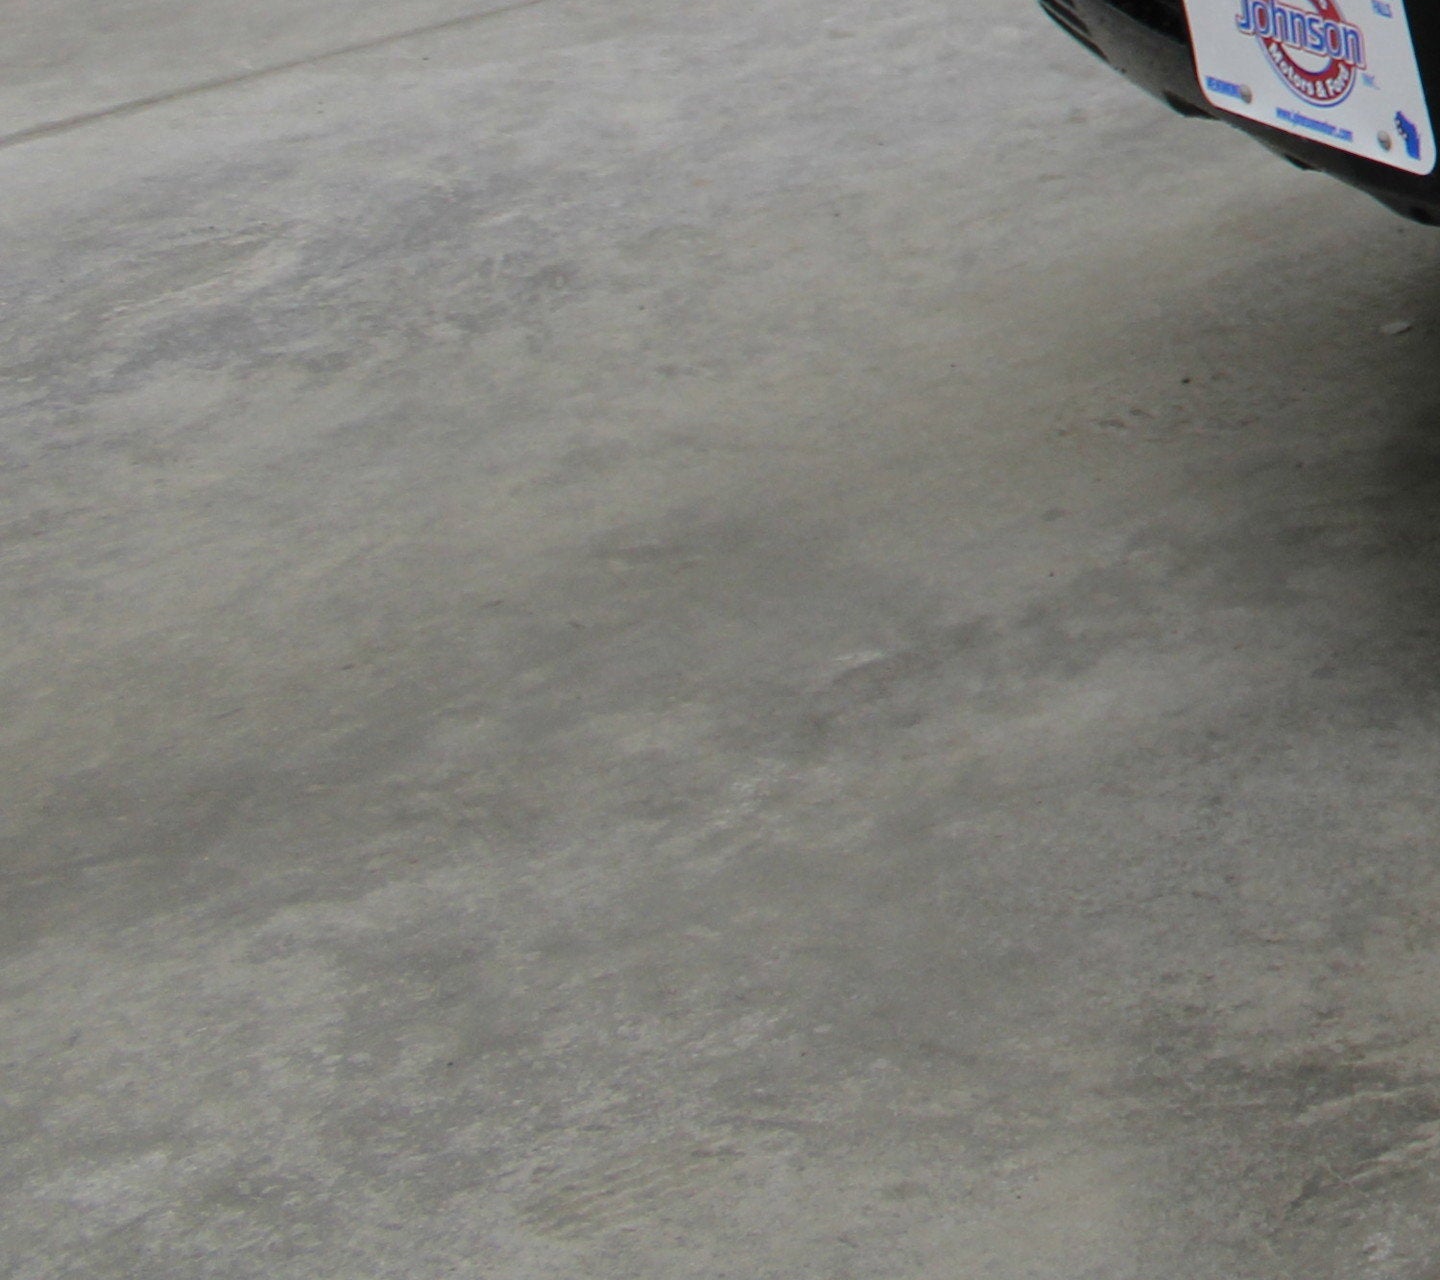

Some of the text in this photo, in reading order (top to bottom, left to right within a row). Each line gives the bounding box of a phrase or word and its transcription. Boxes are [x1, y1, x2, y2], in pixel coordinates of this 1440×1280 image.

[1267, 42, 1315, 97] Motors
[1315, 79, 1329, 99] &
[1324, 64, 1349, 96] Ford
